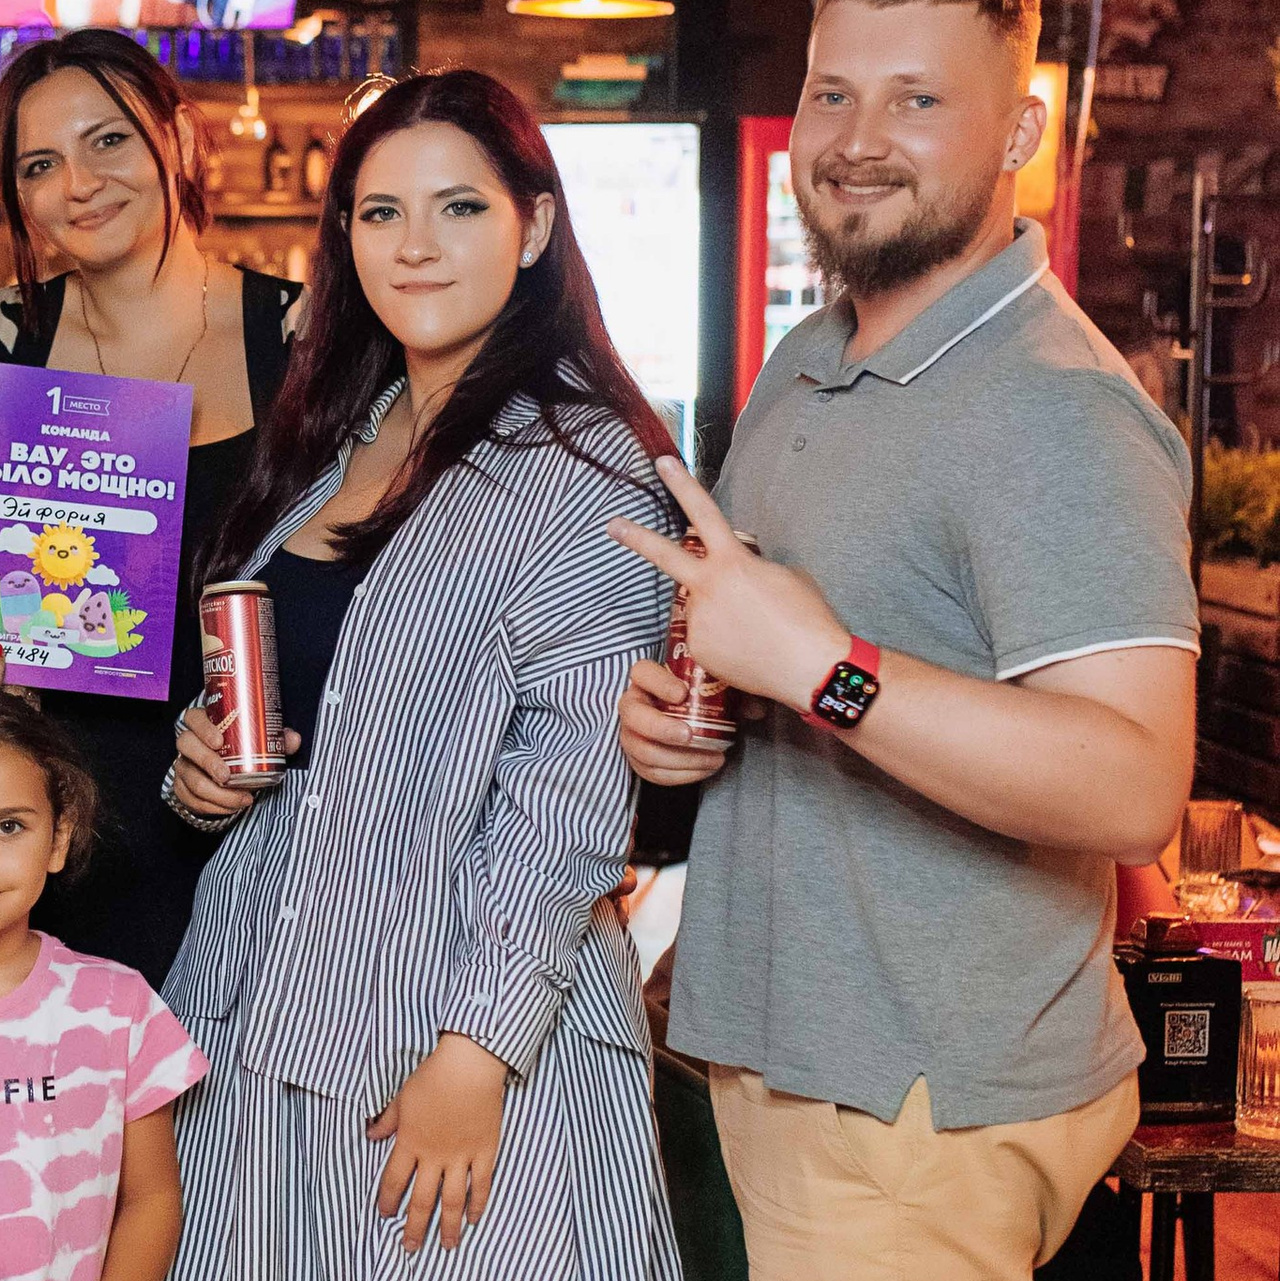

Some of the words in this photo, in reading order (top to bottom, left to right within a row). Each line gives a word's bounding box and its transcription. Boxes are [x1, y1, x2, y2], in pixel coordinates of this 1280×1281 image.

[46, 386, 61, 415] 1
[69, 400, 101, 412] МЕСТО
[41, 424, 111, 442] КОМАНДА
[10, 442, 72, 470] ВАУ,
[80, 450, 136, 474] ЭТО
[58, 468, 176, 501] МОЩНО!
[2, 497, 107, 526] Эйфория
[16, 646, 49, 666] 484
